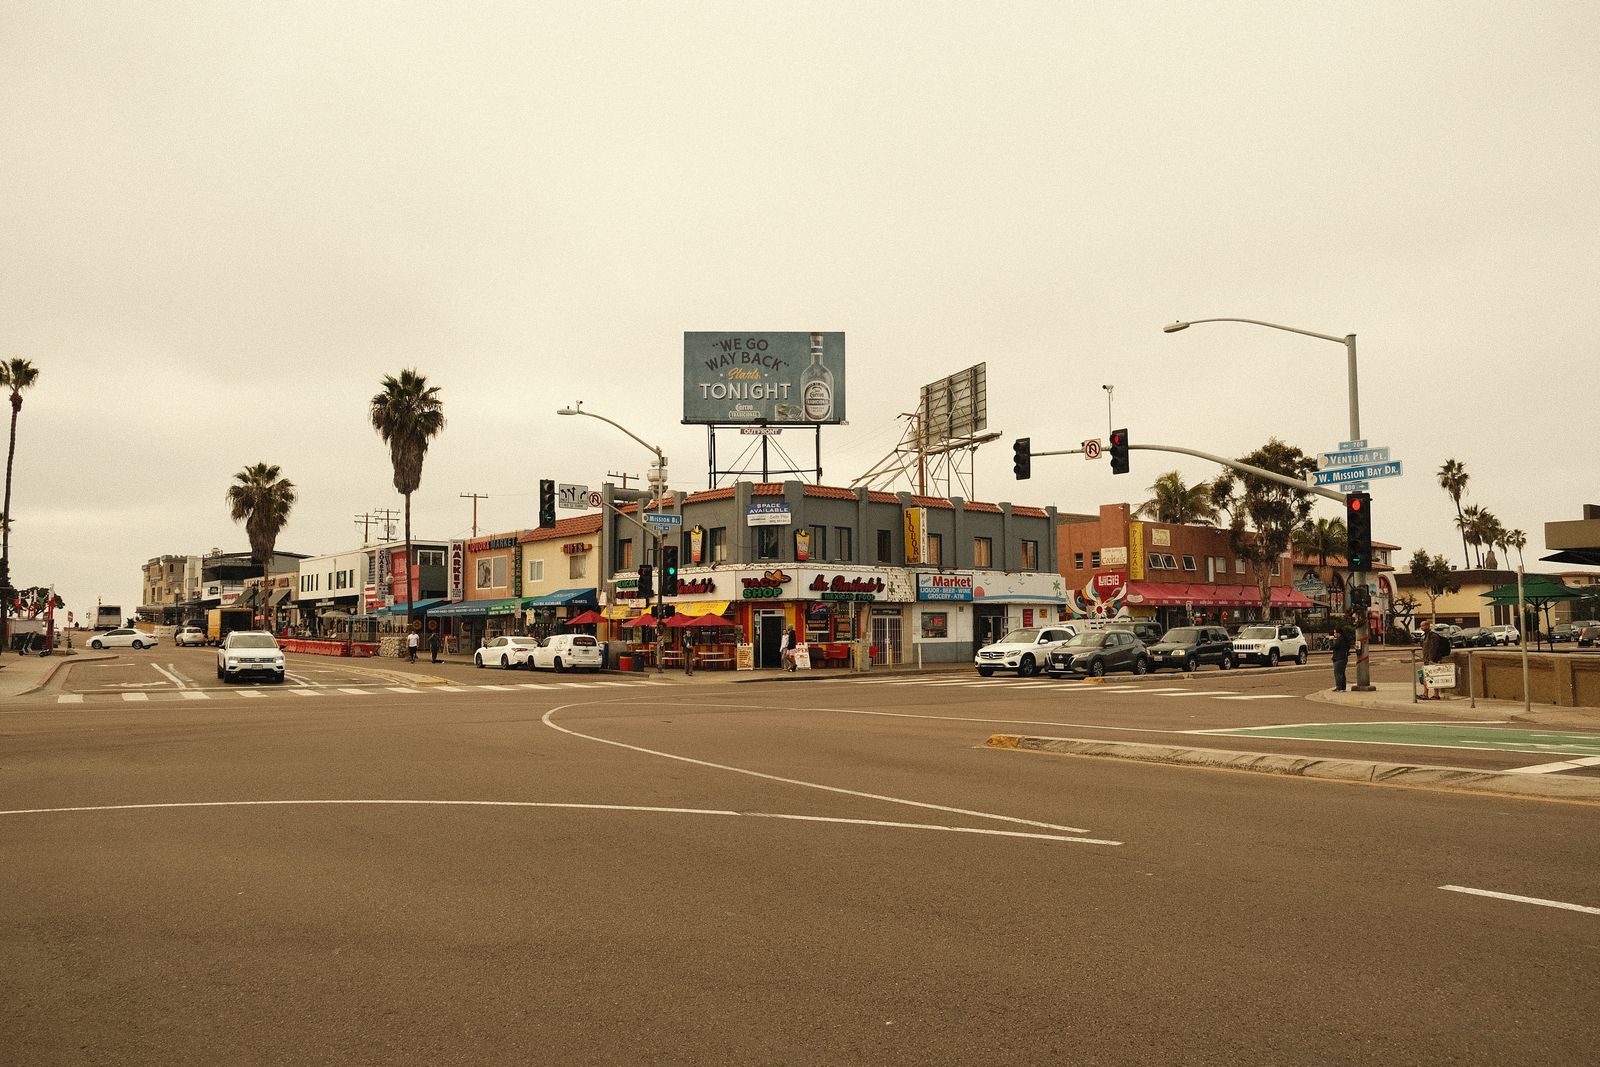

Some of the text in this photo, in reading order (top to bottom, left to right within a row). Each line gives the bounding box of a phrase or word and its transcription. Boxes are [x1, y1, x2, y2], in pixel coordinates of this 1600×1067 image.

[746, 338, 769, 351] GO
[705, 352, 736, 371] WAY
[728, 367, 761, 381] Starts
[699, 382, 792, 400] TONIGHT
[1330, 451, 1387, 464] VENTURA PL.
[1318, 465, 1399, 483] W. MISSION BAY DR.
[650, 515, 670, 523] MISSION
[905, 510, 919, 556] LIQUOR
[490, 537, 516, 550] MARKET
[453, 543, 462, 588] MARKET
[741, 577, 781, 588] TACO
[932, 576, 971, 587] Market
[743, 587, 783, 599] SHOP
[823, 592, 856, 601] MEXICAN
